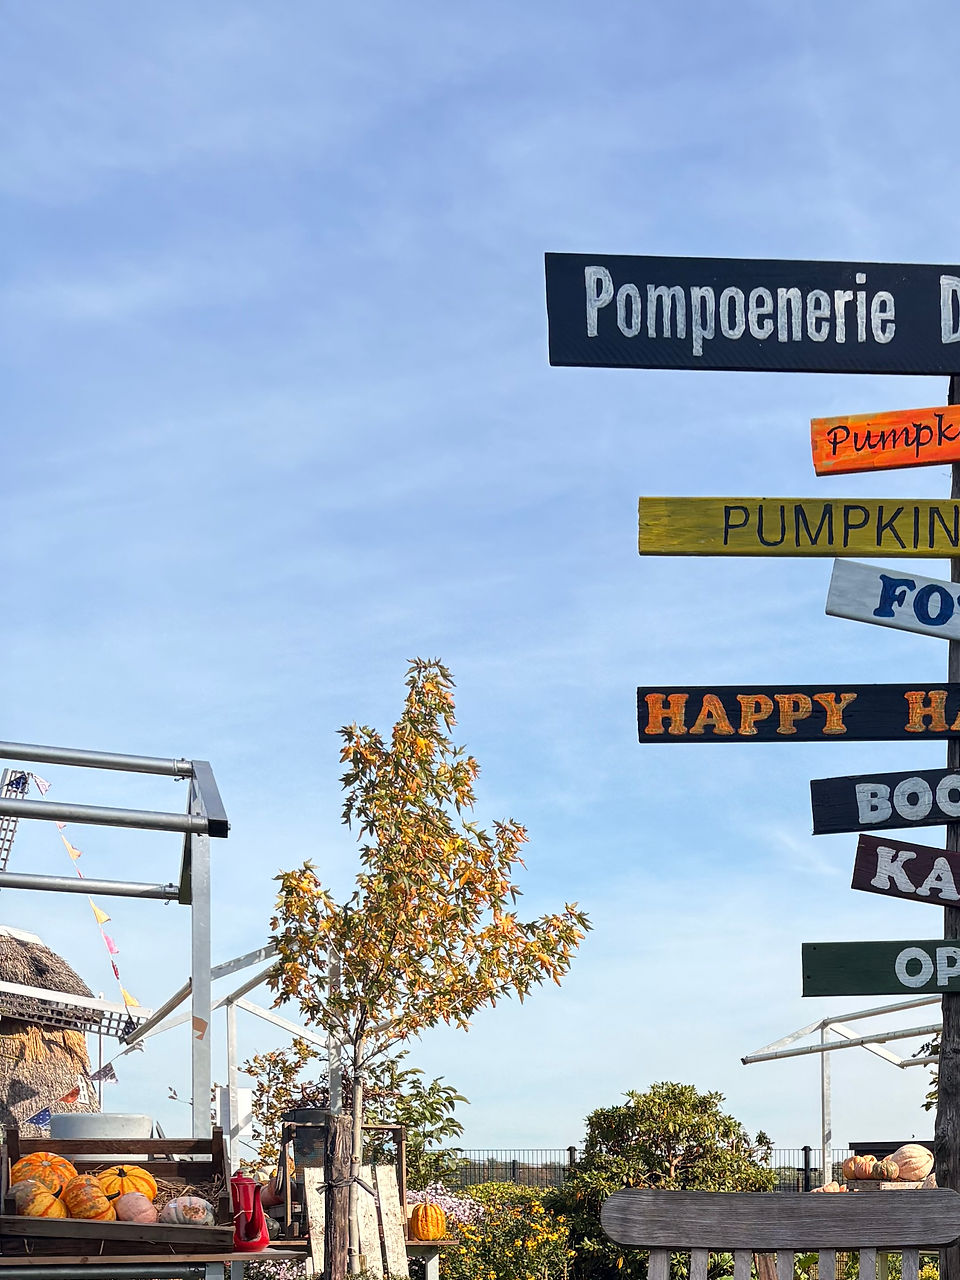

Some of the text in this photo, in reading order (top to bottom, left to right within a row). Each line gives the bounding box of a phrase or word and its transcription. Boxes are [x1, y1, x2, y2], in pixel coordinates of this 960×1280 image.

[585, 264, 896, 357] Pompoenerie
[722, 503, 960, 549] PUMPKIN
[644, 692, 858, 736] HAPPY
